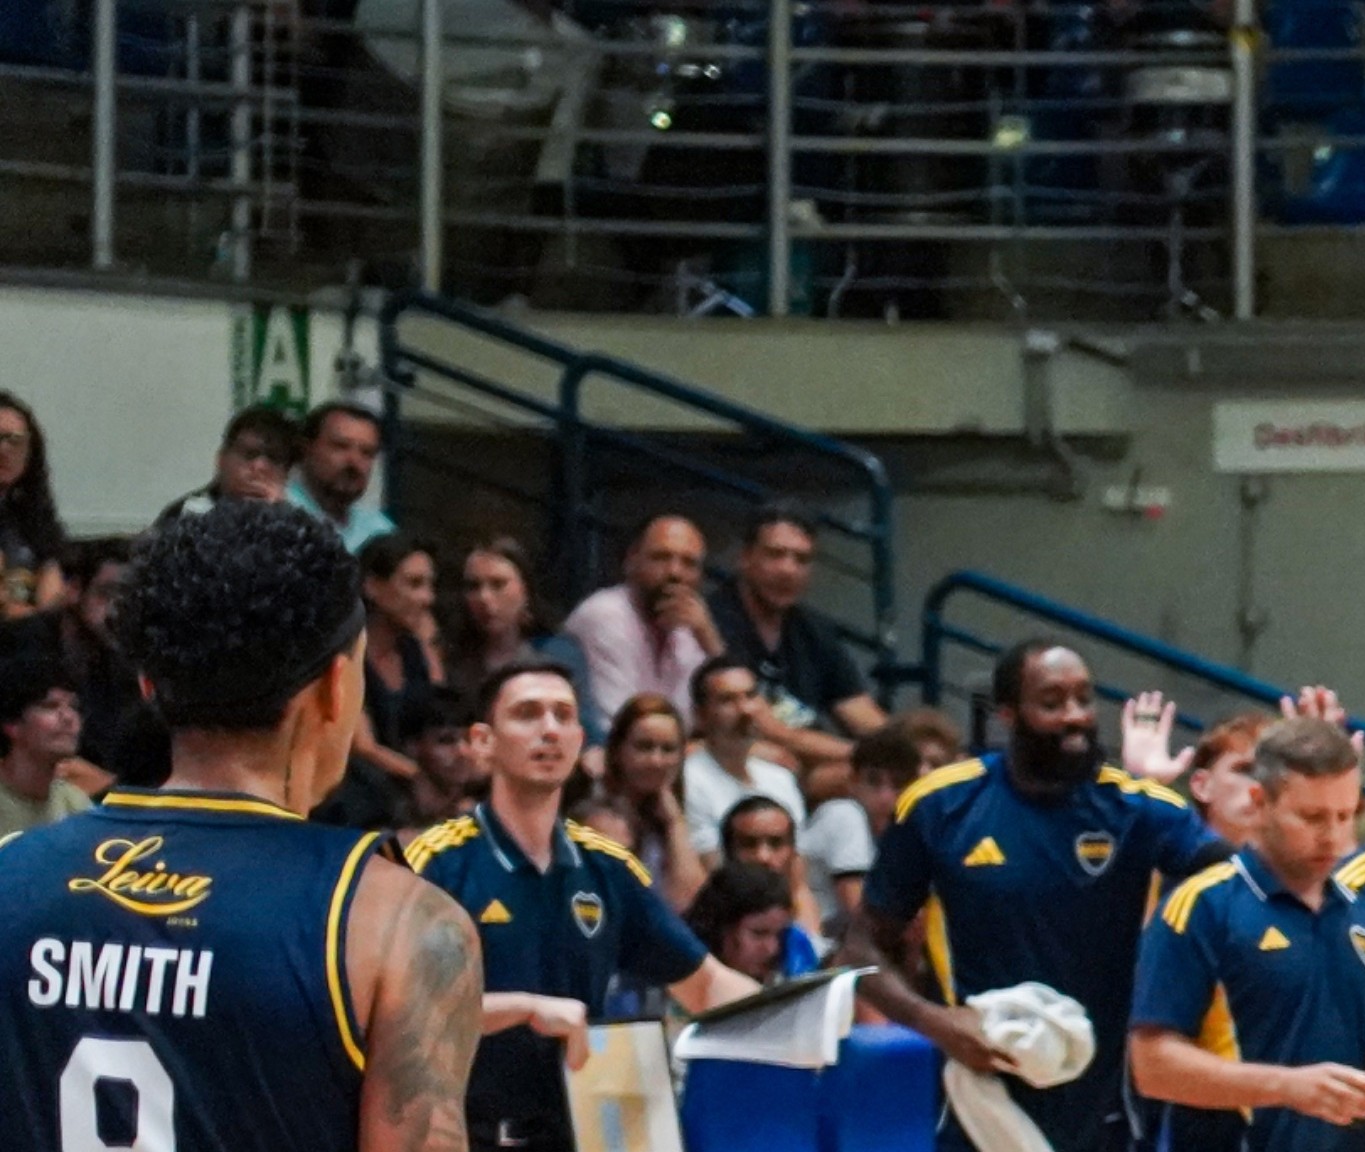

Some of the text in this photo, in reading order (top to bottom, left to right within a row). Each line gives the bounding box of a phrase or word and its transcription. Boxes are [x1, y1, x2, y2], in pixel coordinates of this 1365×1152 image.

[256, 304, 306, 399] A
[68, 835, 213, 916] Leiva
[28, 937, 214, 1018] SMITH
